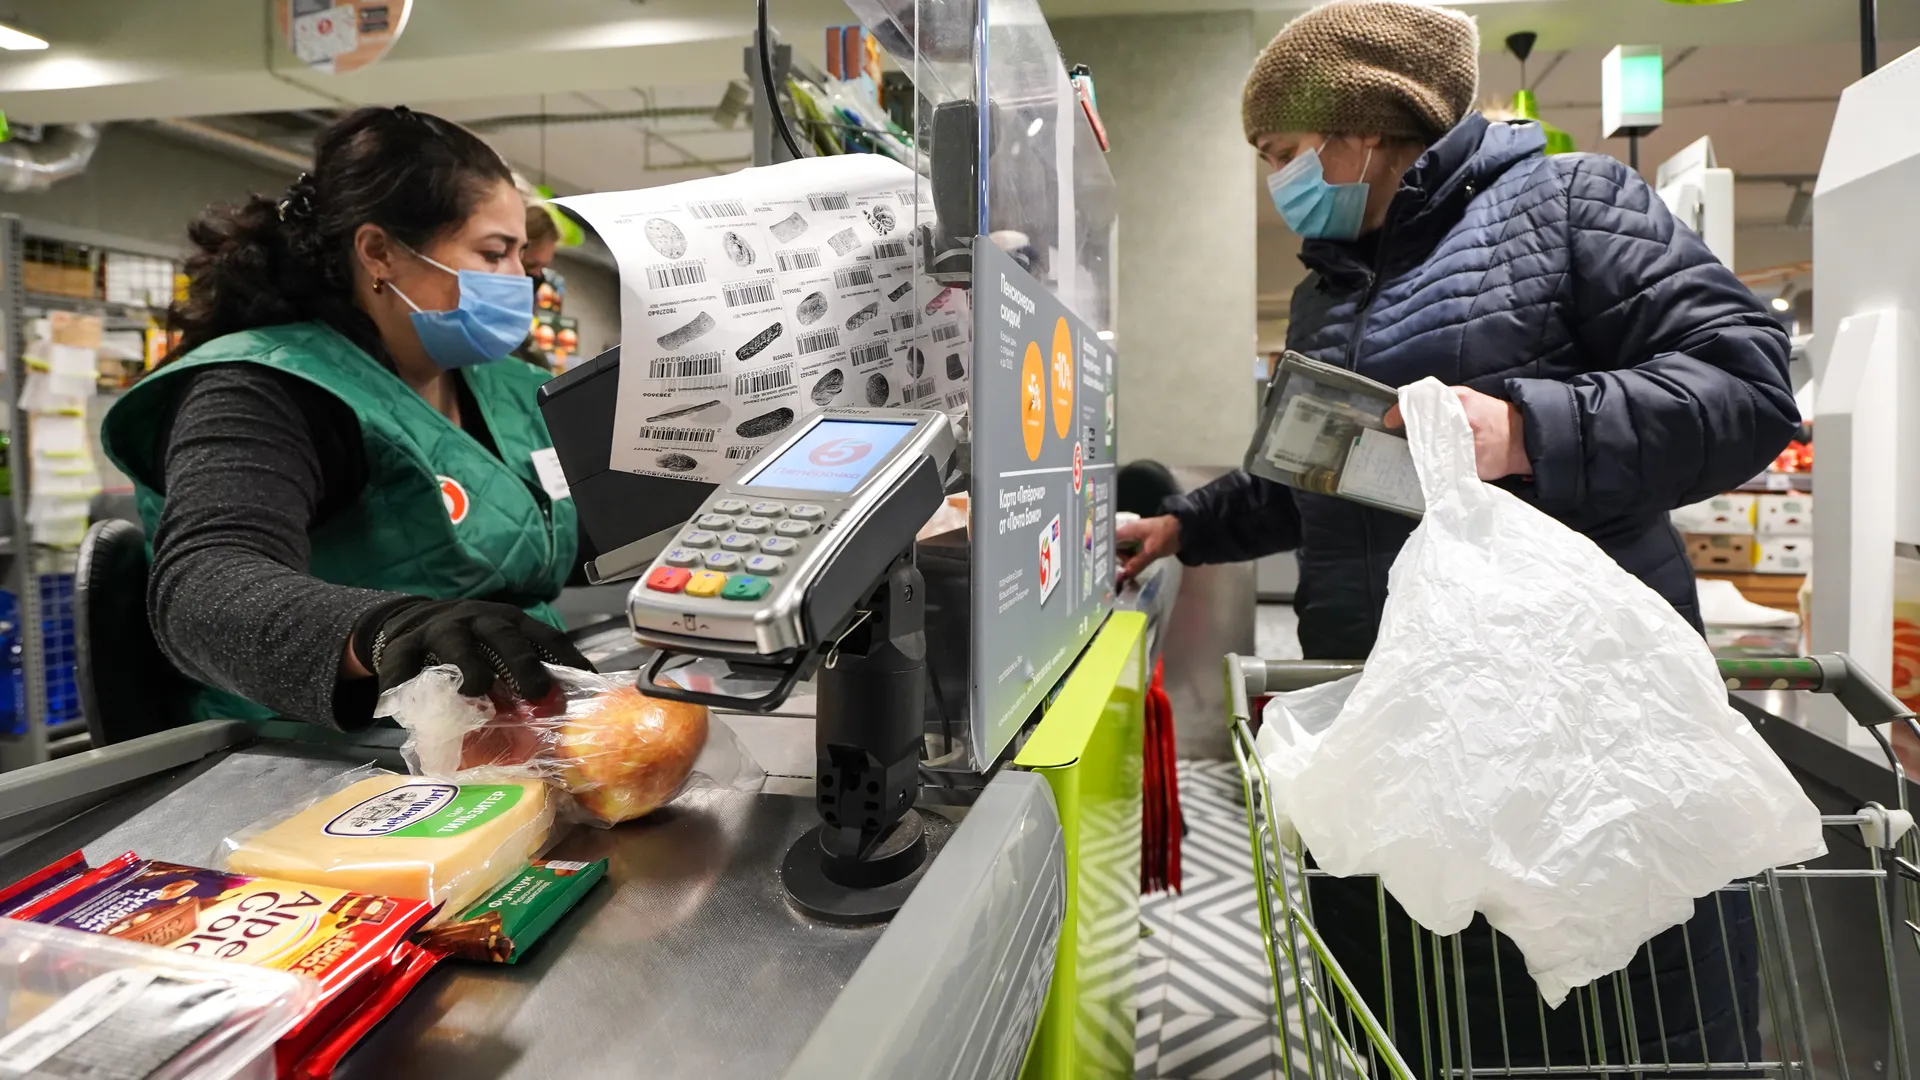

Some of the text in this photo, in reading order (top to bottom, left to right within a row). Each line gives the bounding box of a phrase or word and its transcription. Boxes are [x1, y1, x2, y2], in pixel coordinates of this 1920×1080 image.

[1000, 272, 1036, 316] Пенсионерам
[1000, 304, 1021, 330] скидки!
[689, 351, 718, 360] 000000
[773, 467, 861, 480] Пятёрочка
[999, 484, 1046, 512] Карта «Пятёрочка»
[999, 507, 1042, 535] от «Почта Банка»
[726, 535, 736, 543] 8
[711, 552, 722, 562] 0
[438, 790, 507, 834] ТИЛЬЗИТЕР
[488, 876, 536, 908] Фундук
[89, 889, 164, 932] Фундук
[214, 890, 322, 959] Alpe
